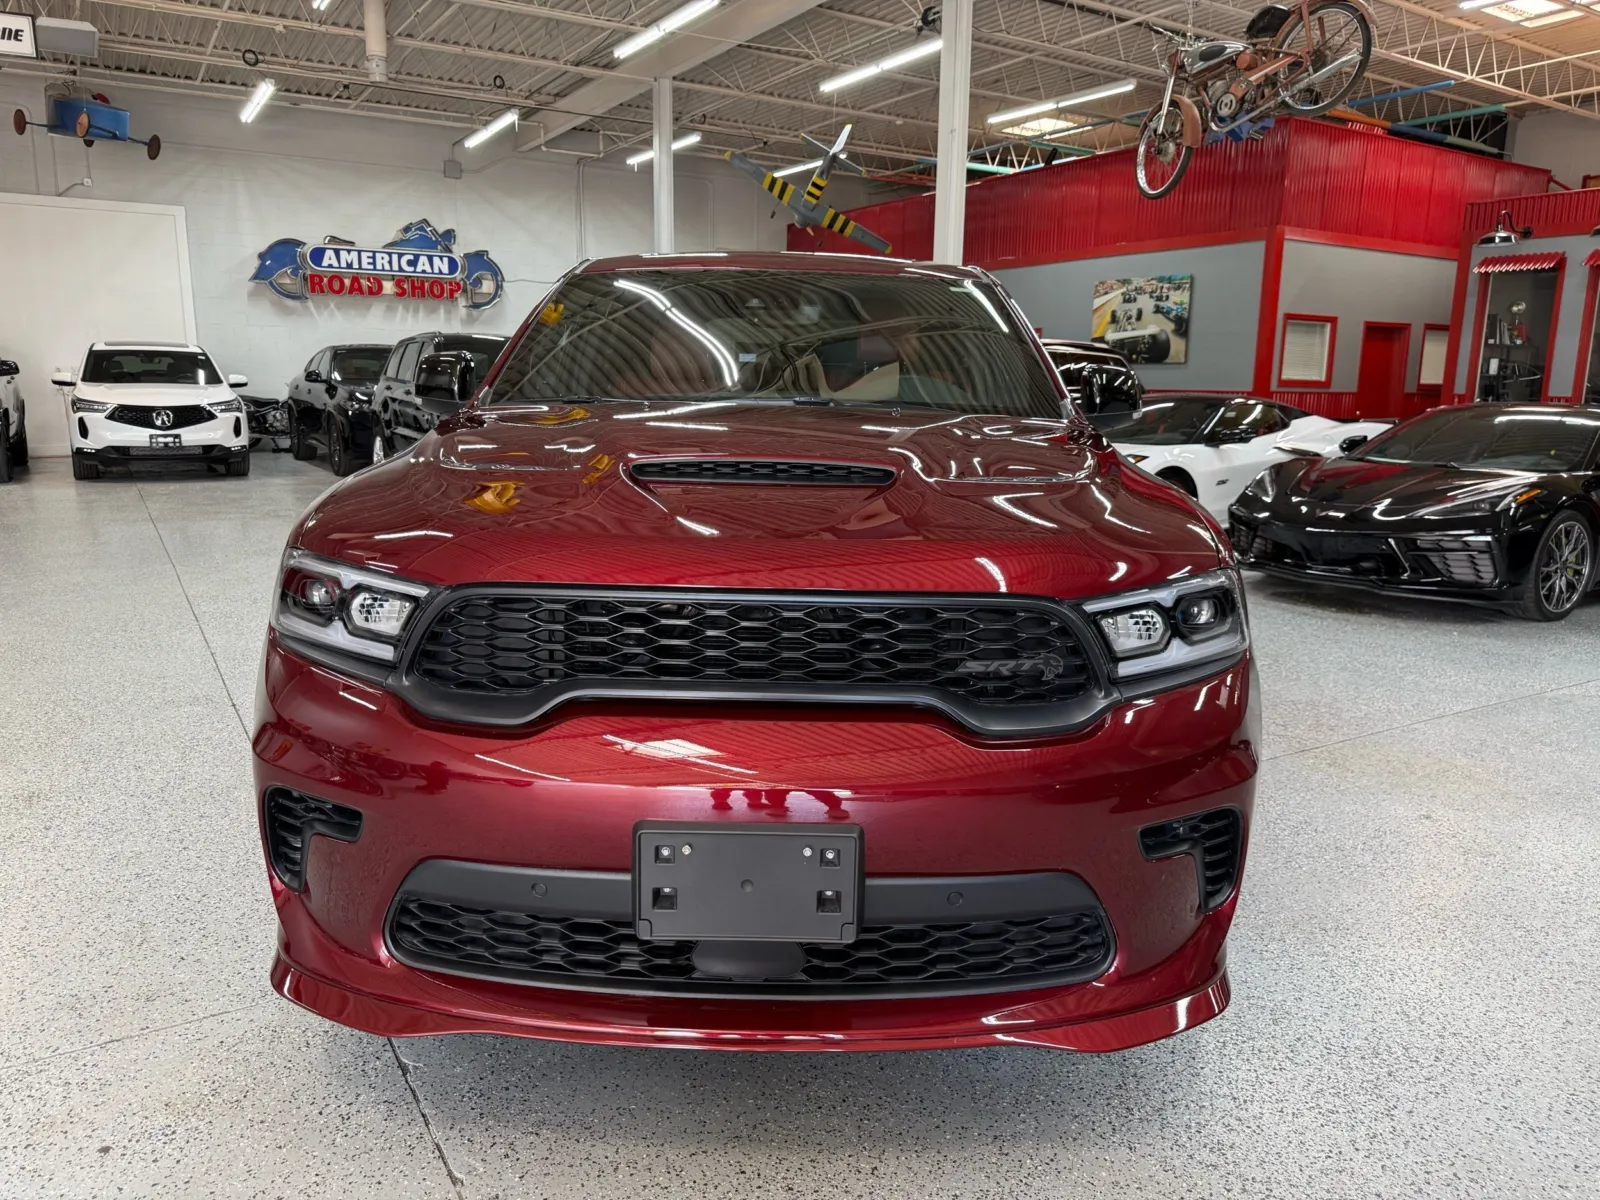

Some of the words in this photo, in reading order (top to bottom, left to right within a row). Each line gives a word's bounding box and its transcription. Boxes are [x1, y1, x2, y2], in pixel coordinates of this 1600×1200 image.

[0, 27, 24, 42] NE
[321, 249, 450, 274] AMERICAN
[307, 273, 384, 297] ROAD
[394, 277, 463, 300] SHOP
[957, 660, 1044, 676] SRT
